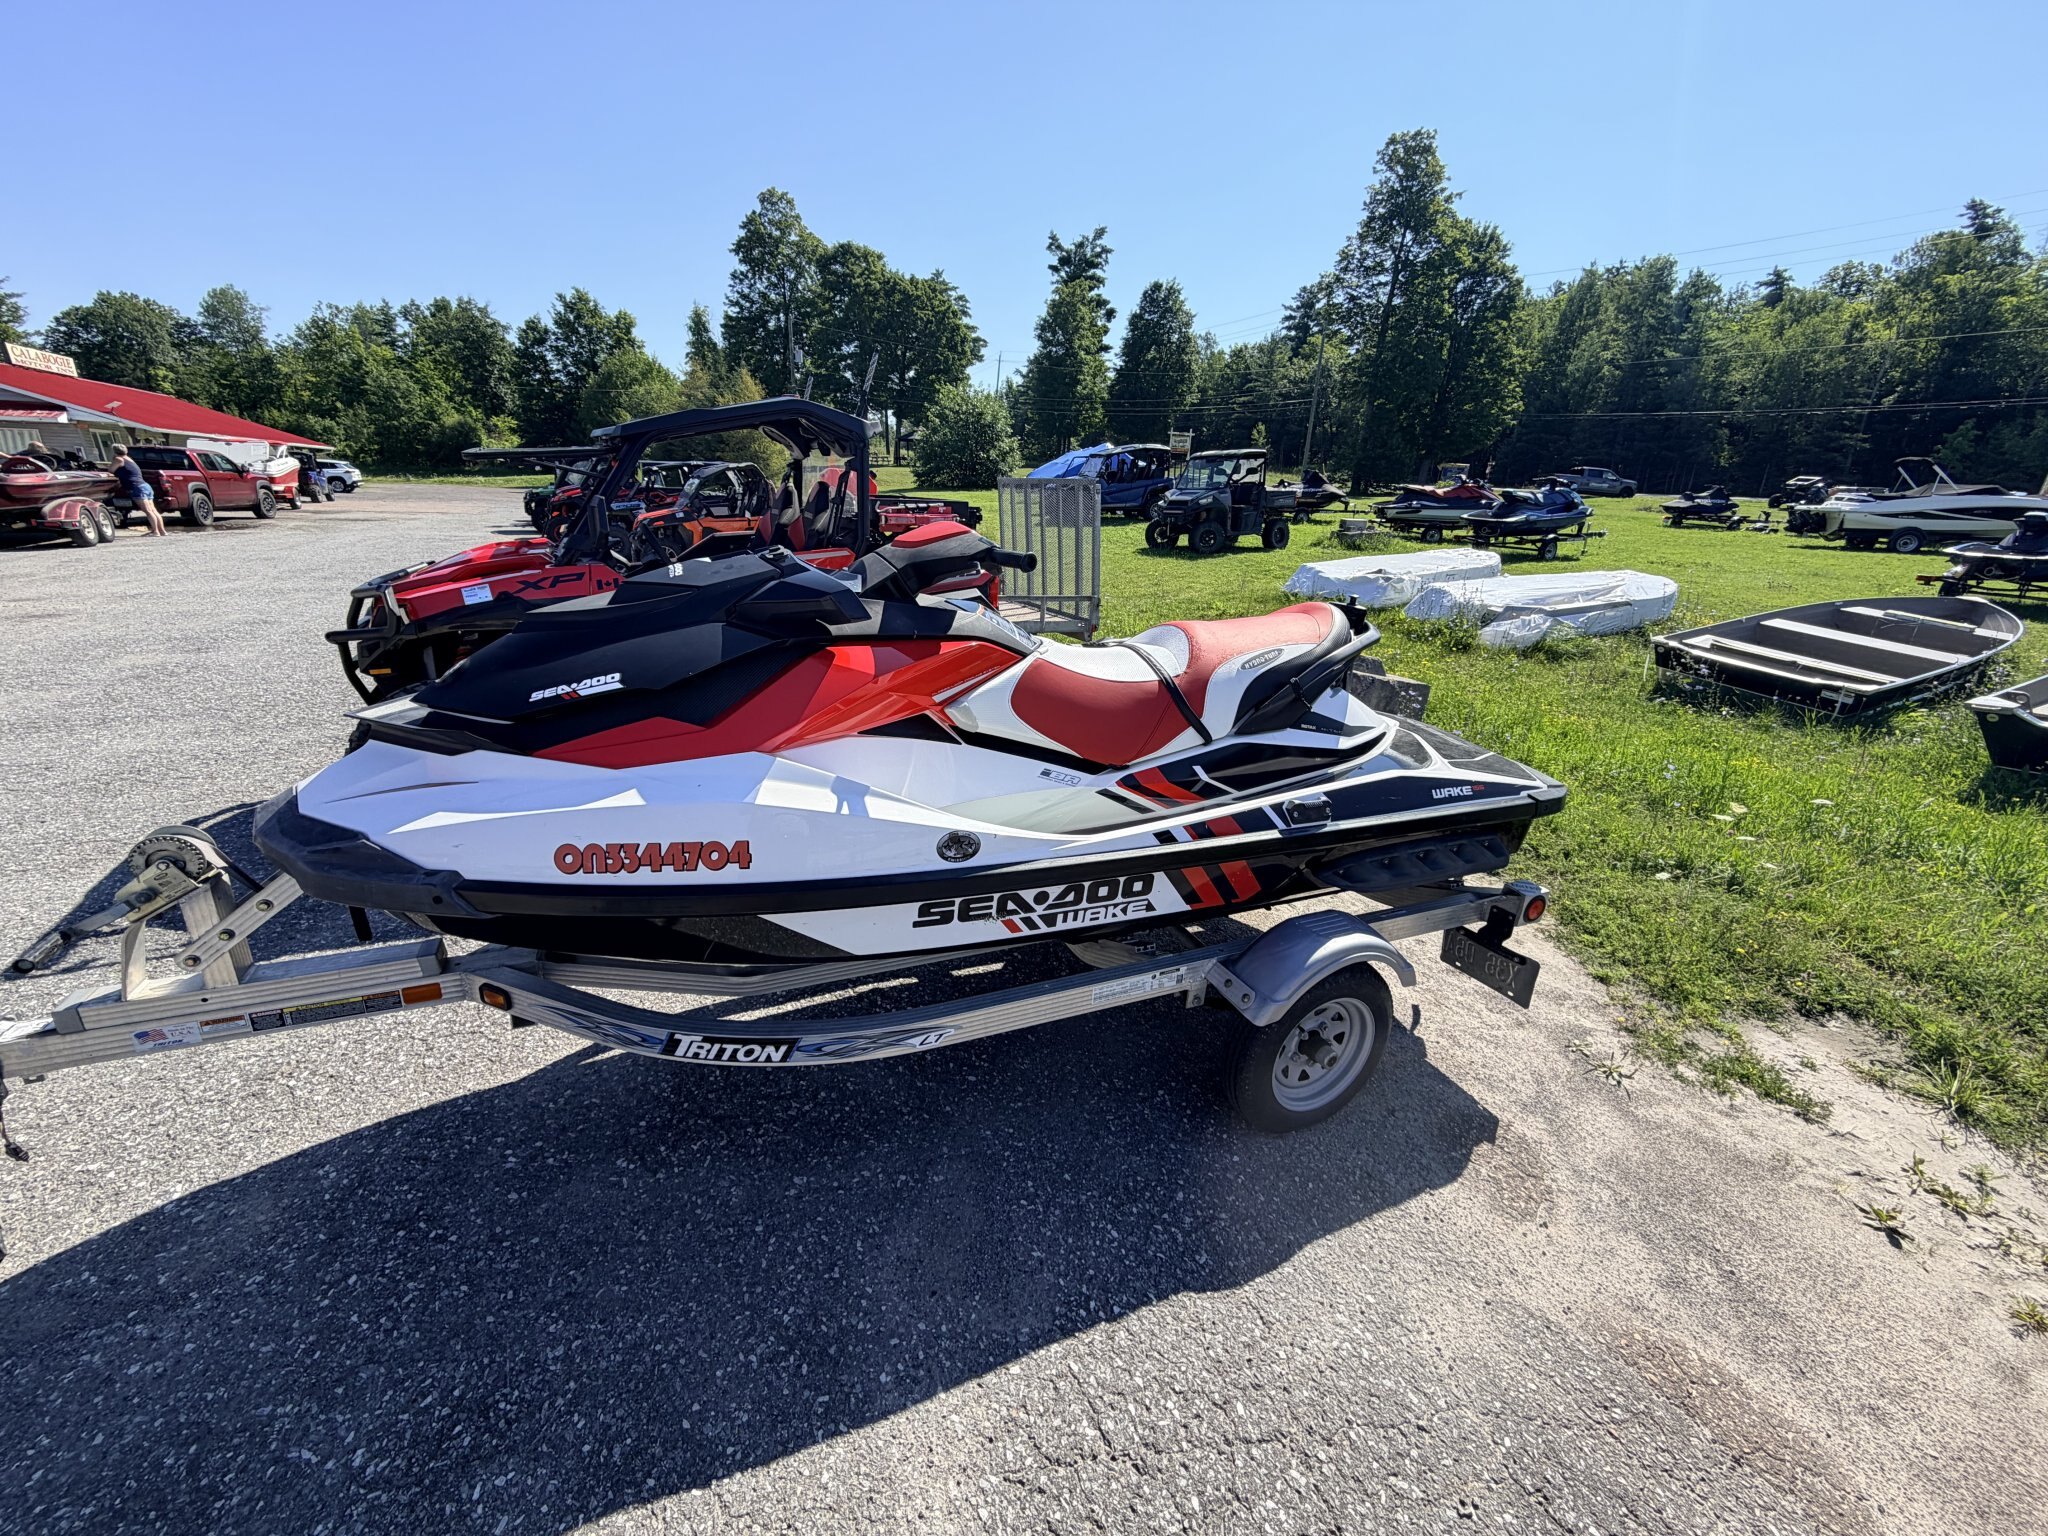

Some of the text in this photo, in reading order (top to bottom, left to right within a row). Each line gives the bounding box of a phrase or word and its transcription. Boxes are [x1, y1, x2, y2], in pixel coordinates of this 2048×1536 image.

[11, 346, 73, 369] CALABOGIE
[511, 571, 586, 595] XP
[1431, 785, 1474, 799] WAKE
[1056, 900, 1150, 927] WAKE
[673, 1033, 789, 1062] TRITON
[919, 1033, 945, 1046] LT
